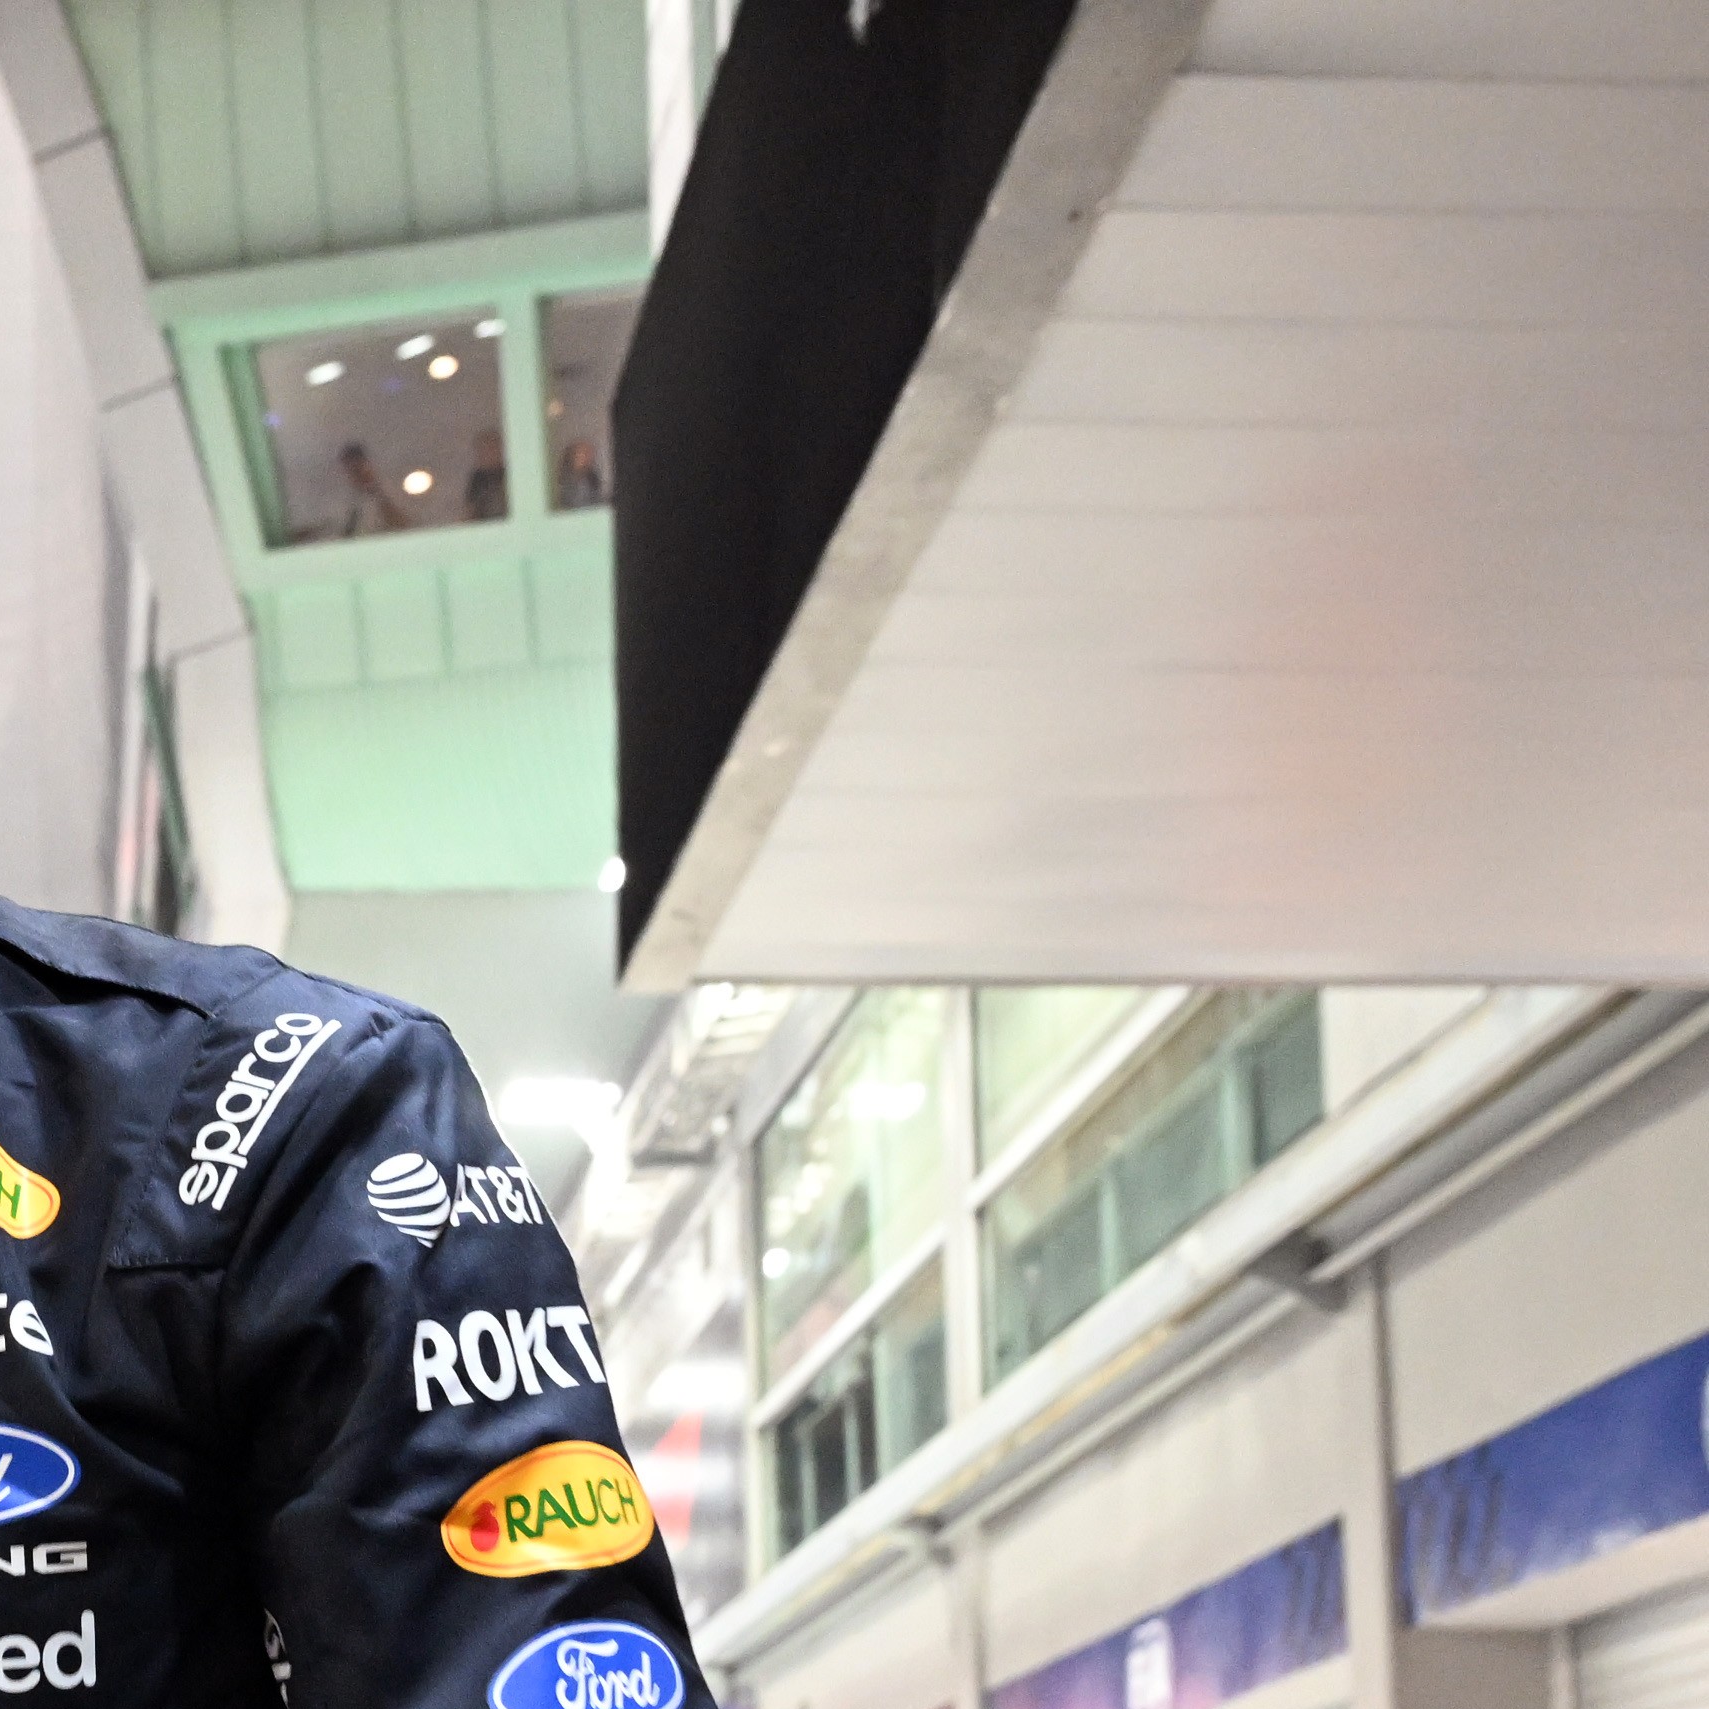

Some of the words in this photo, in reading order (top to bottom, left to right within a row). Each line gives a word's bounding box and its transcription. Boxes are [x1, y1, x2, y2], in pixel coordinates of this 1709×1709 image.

[179, 1012, 341, 1210] sparco
[450, 1163, 543, 1227] AT&T
[413, 1304, 607, 1412] ROKT
[505, 1478, 640, 1543] RAUCH
